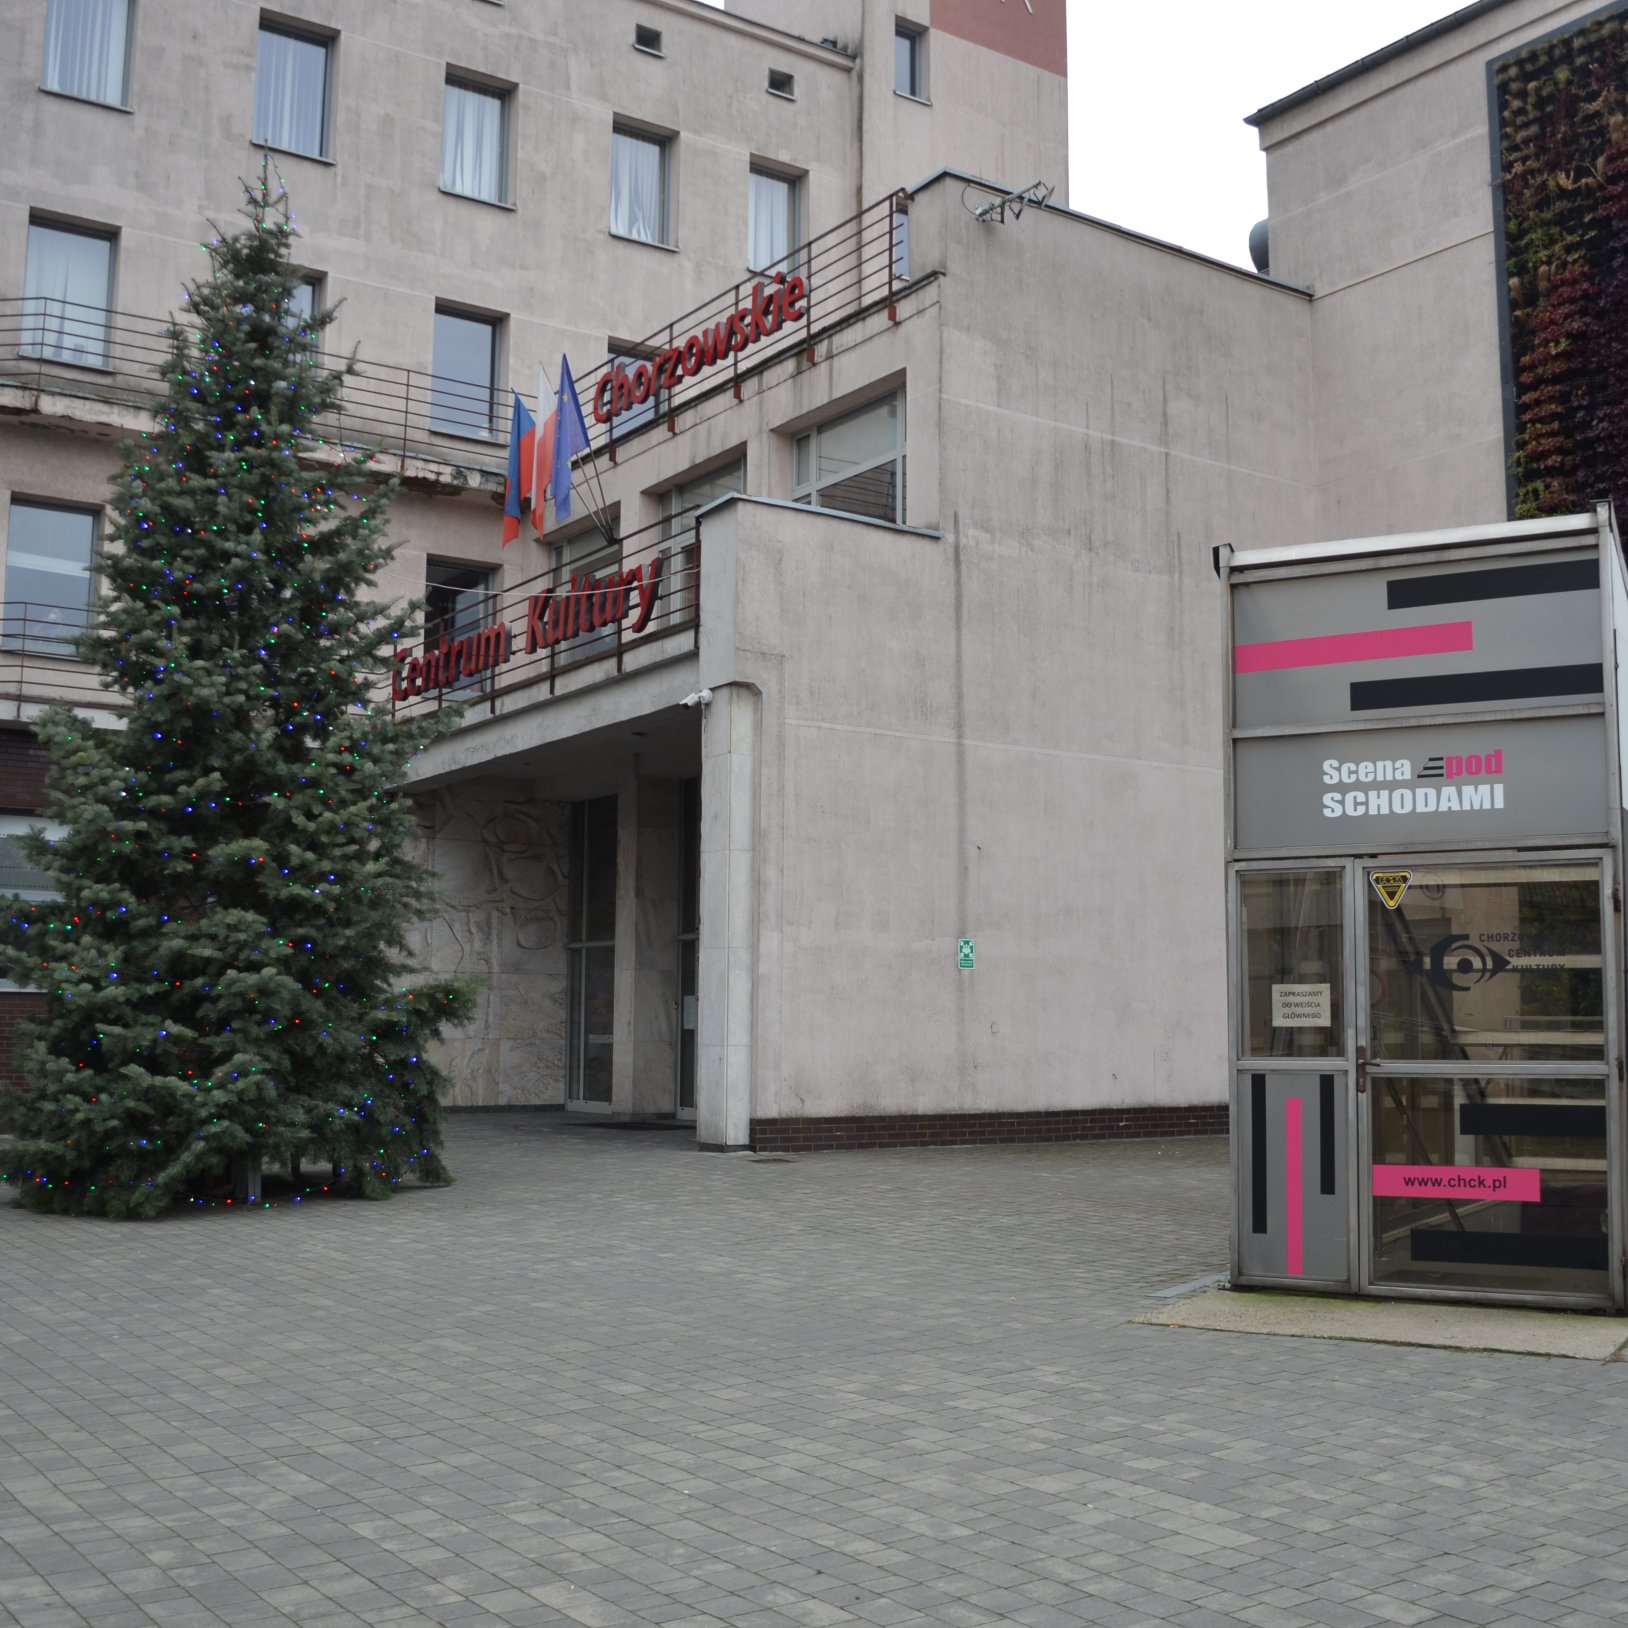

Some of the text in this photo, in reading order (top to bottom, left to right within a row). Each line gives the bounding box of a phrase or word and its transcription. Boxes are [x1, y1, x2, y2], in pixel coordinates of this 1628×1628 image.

[593, 271, 809, 424] Chorzowskie
[392, 557, 664, 701] Centrum Kultury
[1322, 749, 1503, 785] Scena pod
[1322, 783, 1504, 818] SCHODAMI
[1508, 948, 1566, 958] CENTRUM
[1403, 1175, 1507, 1192] www.chck.pl
